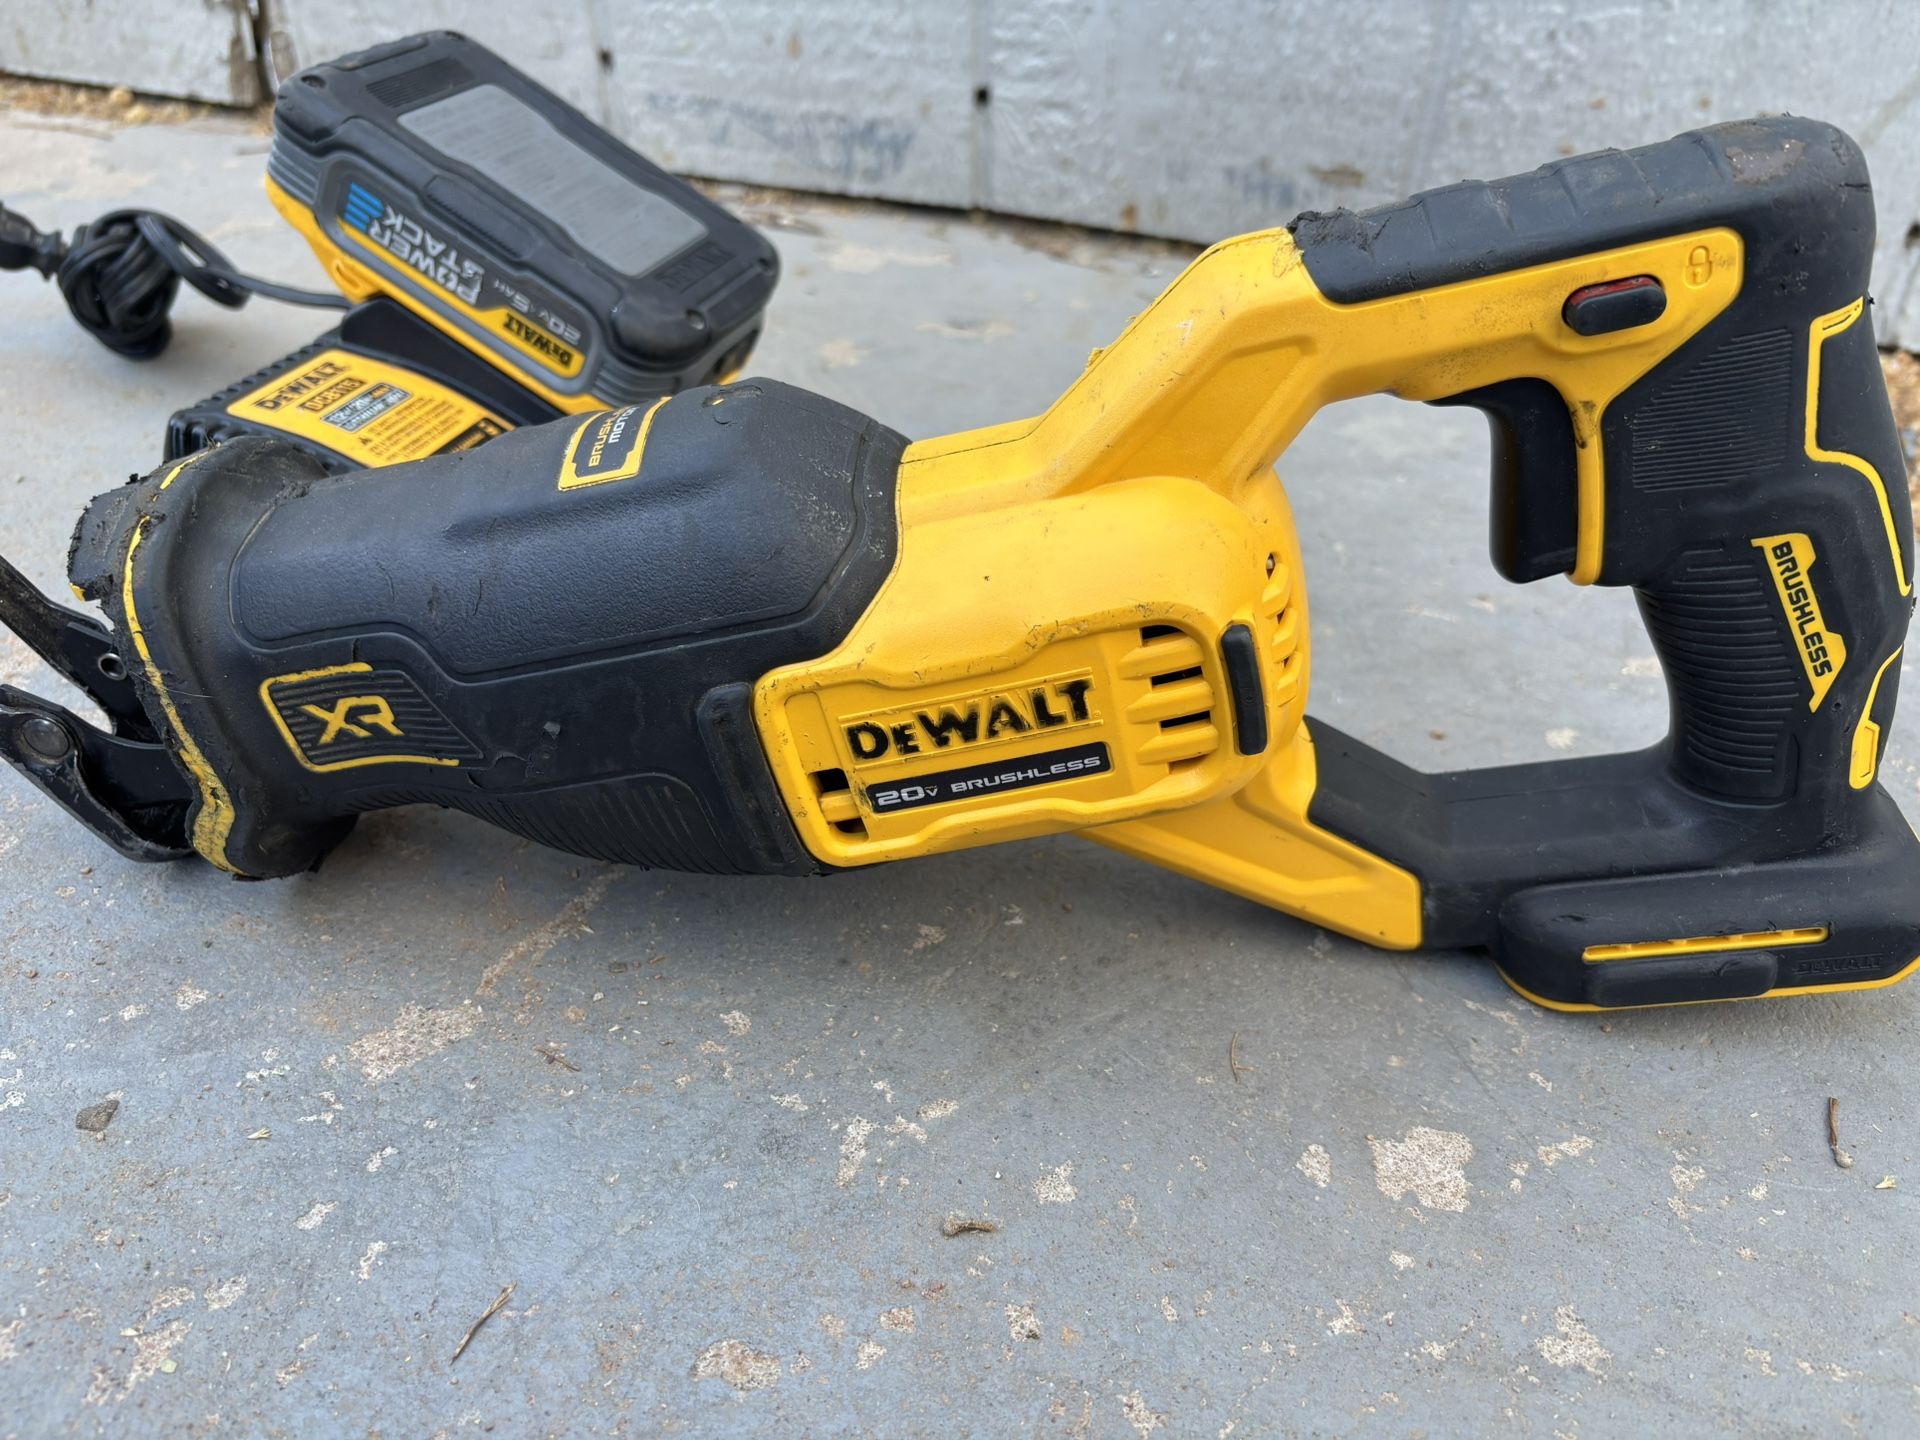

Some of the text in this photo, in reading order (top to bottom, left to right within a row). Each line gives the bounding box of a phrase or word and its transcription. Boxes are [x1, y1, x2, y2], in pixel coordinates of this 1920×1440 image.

[369, 218, 482, 306] POWER
[381, 204, 485, 279] STACK
[1771, 541, 1833, 678] BRUSHLESS
[300, 695, 406, 745] XR
[950, 756, 1101, 793] BRUSHLESS
